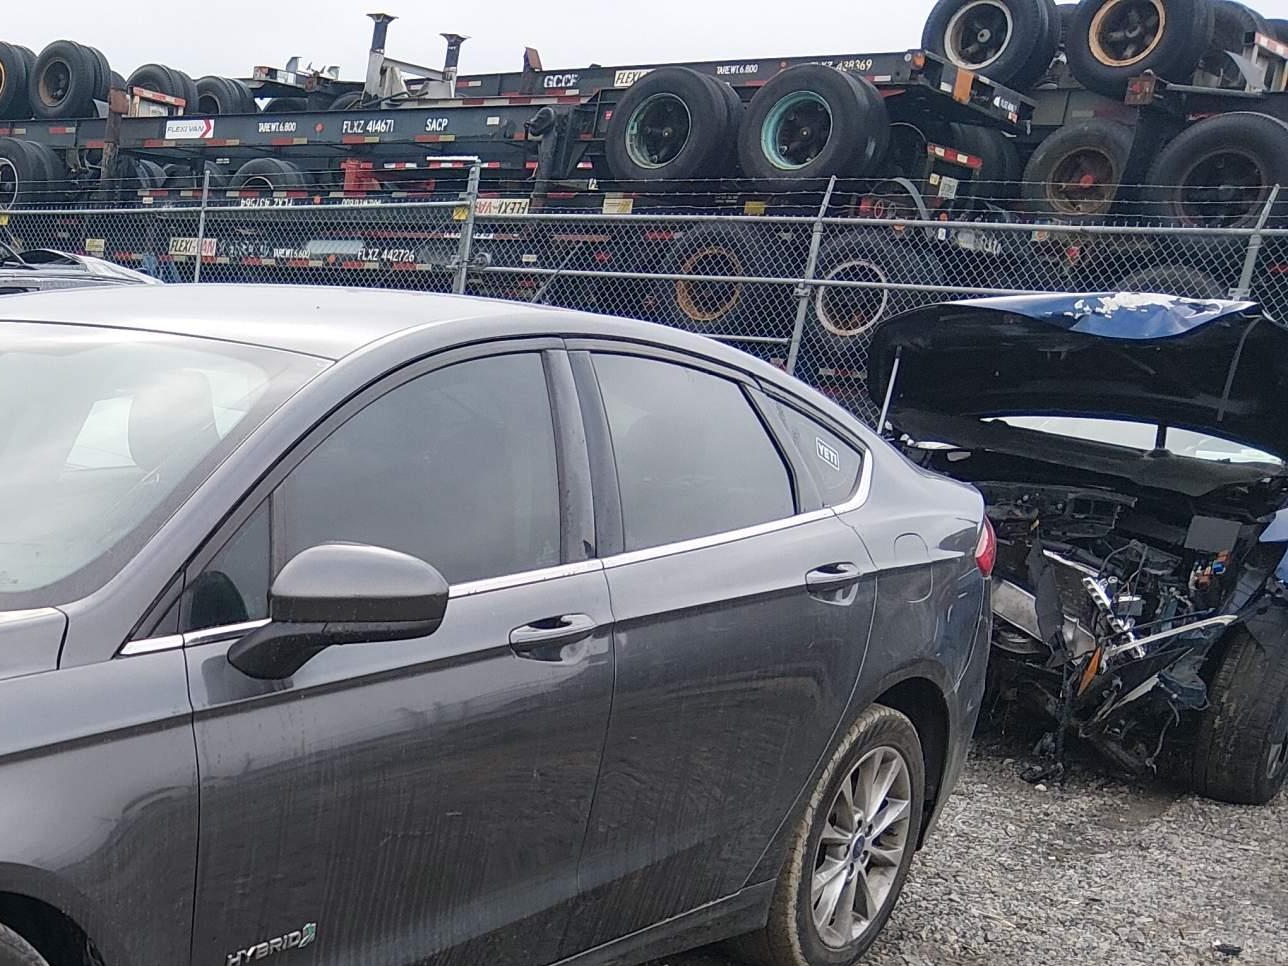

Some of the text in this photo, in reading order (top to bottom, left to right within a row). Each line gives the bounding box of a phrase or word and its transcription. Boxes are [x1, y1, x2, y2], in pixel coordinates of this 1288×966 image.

[342, 120, 365, 133] FLXZ
[425, 118, 449, 132] SACP
[817, 442, 839, 466] YETI
